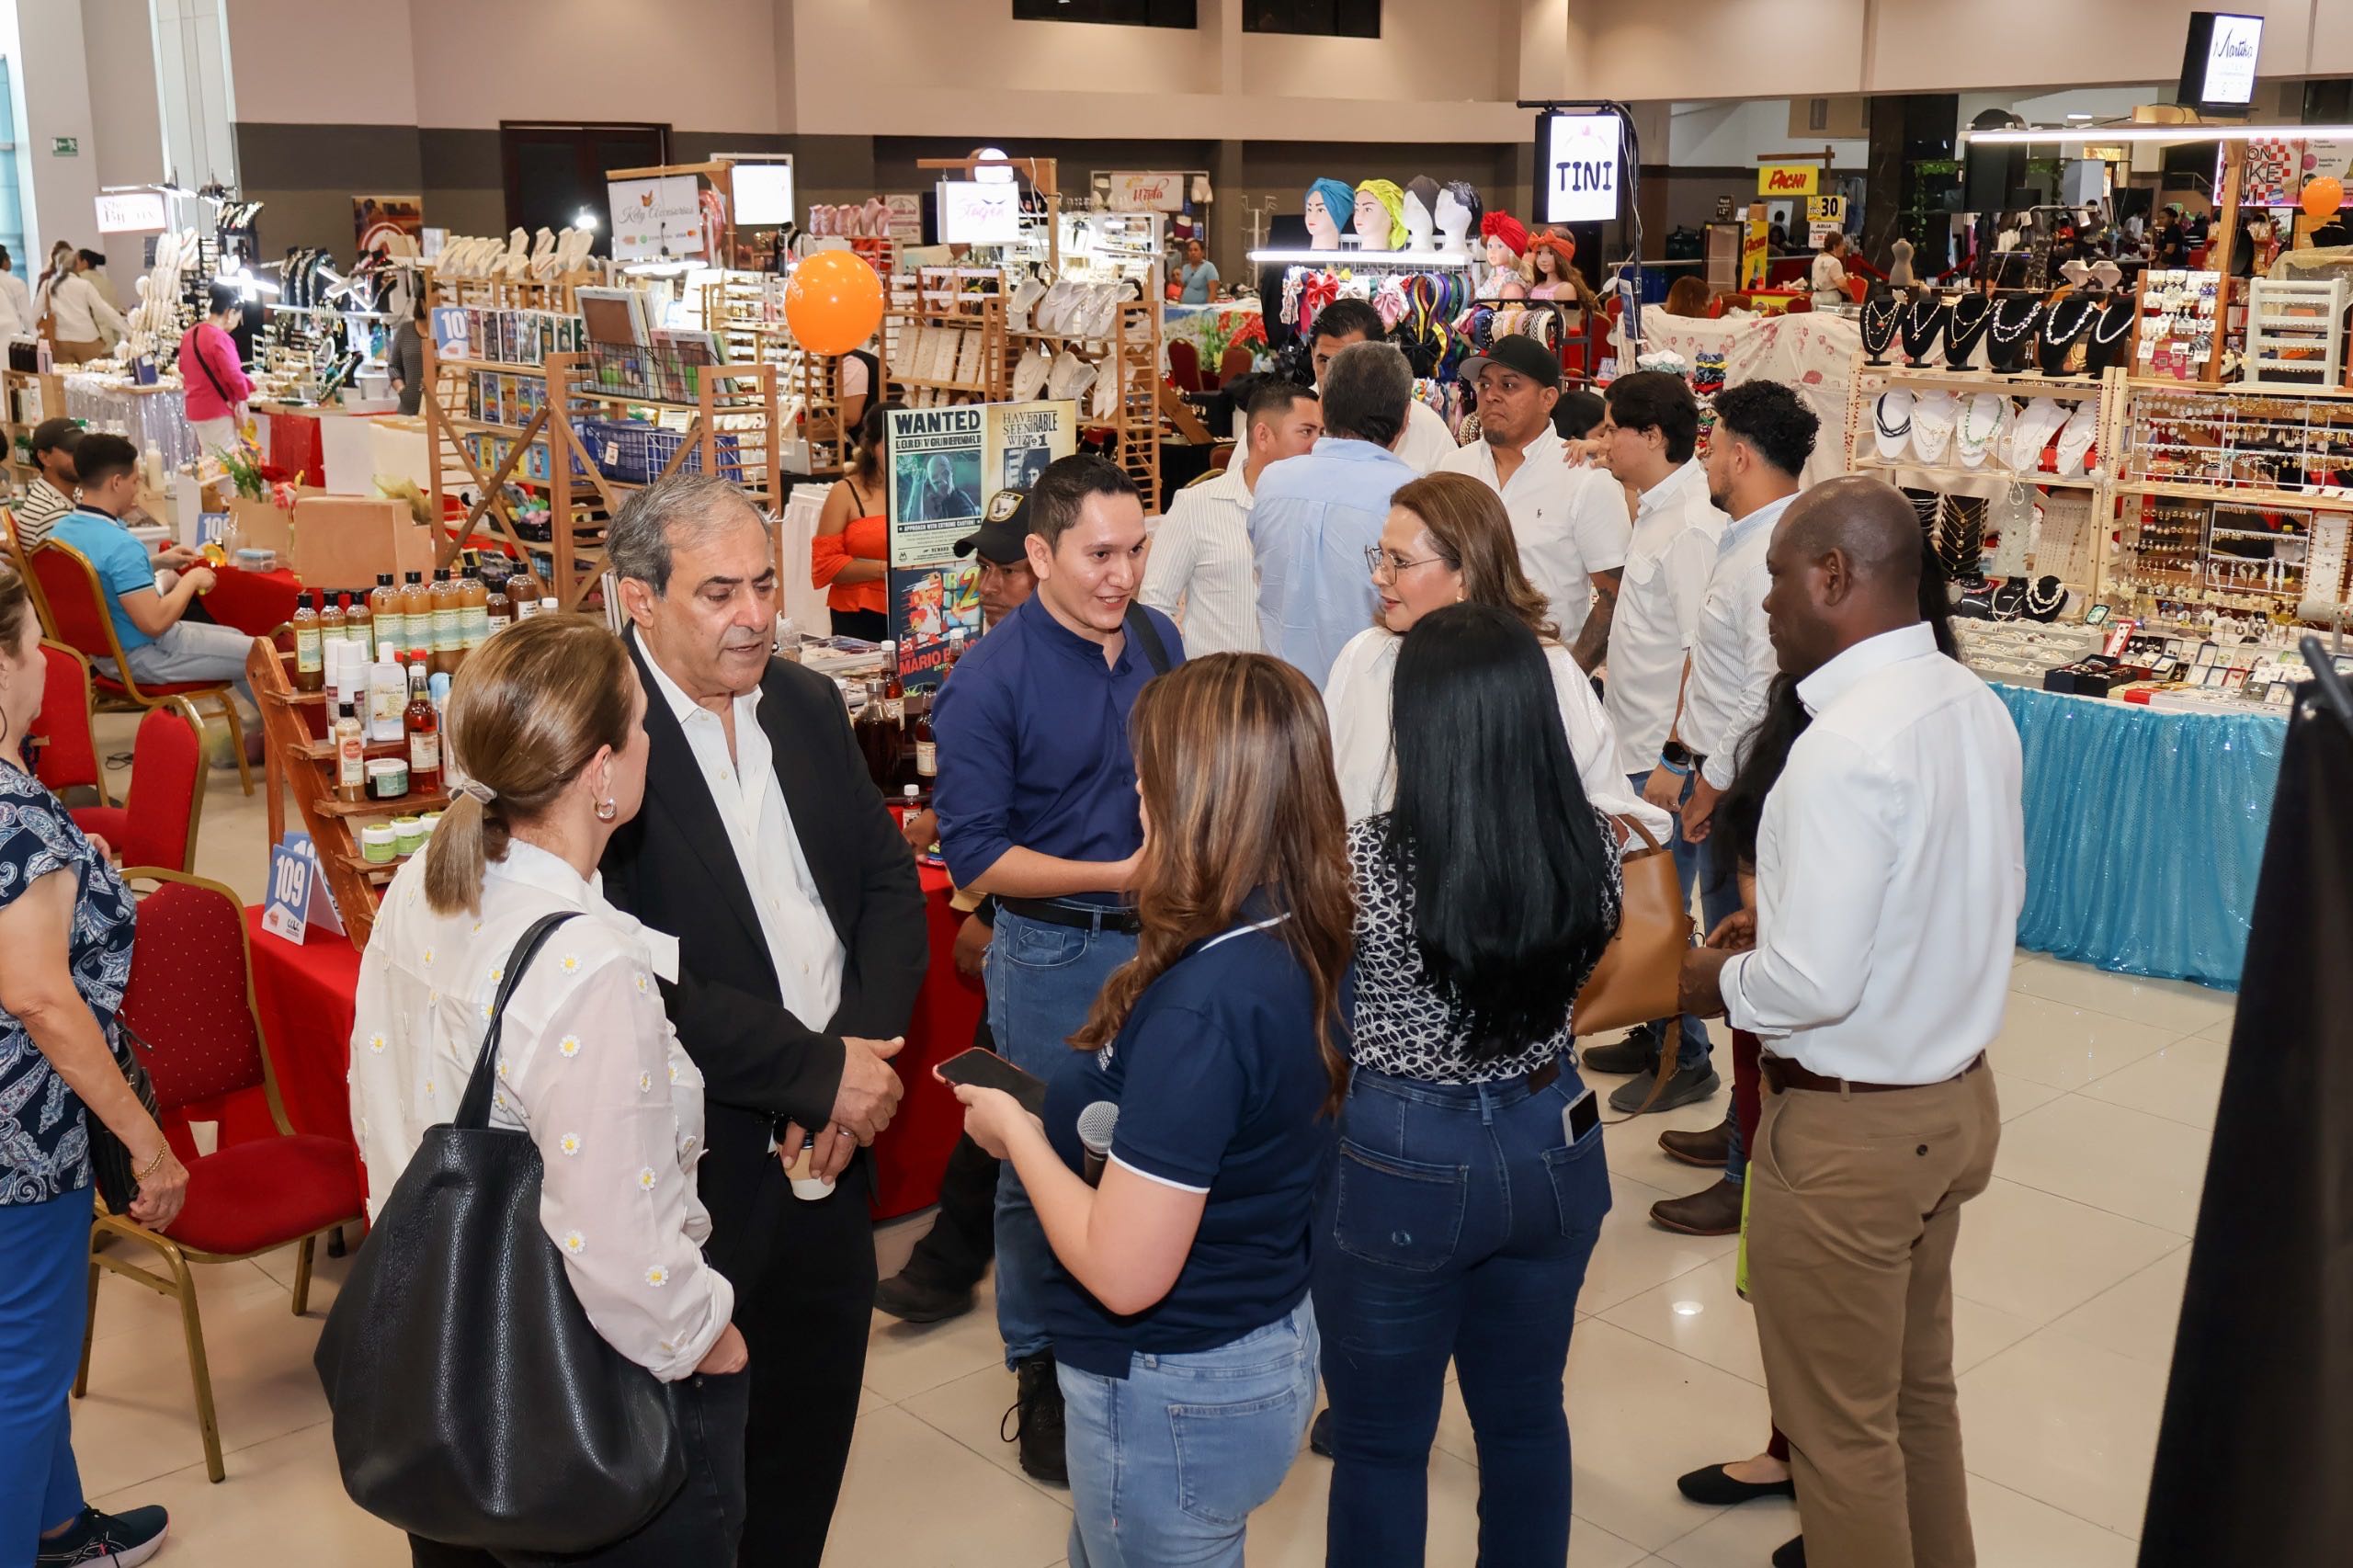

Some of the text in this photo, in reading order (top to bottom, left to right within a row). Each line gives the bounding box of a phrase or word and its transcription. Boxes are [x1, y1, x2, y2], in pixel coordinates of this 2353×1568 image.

[1556, 161, 1612, 191] TINI
[441, 311, 467, 339] 10
[895, 410, 981, 435] WANTED
[899, 650, 941, 676] MARIO
[275, 855, 306, 907] 109
